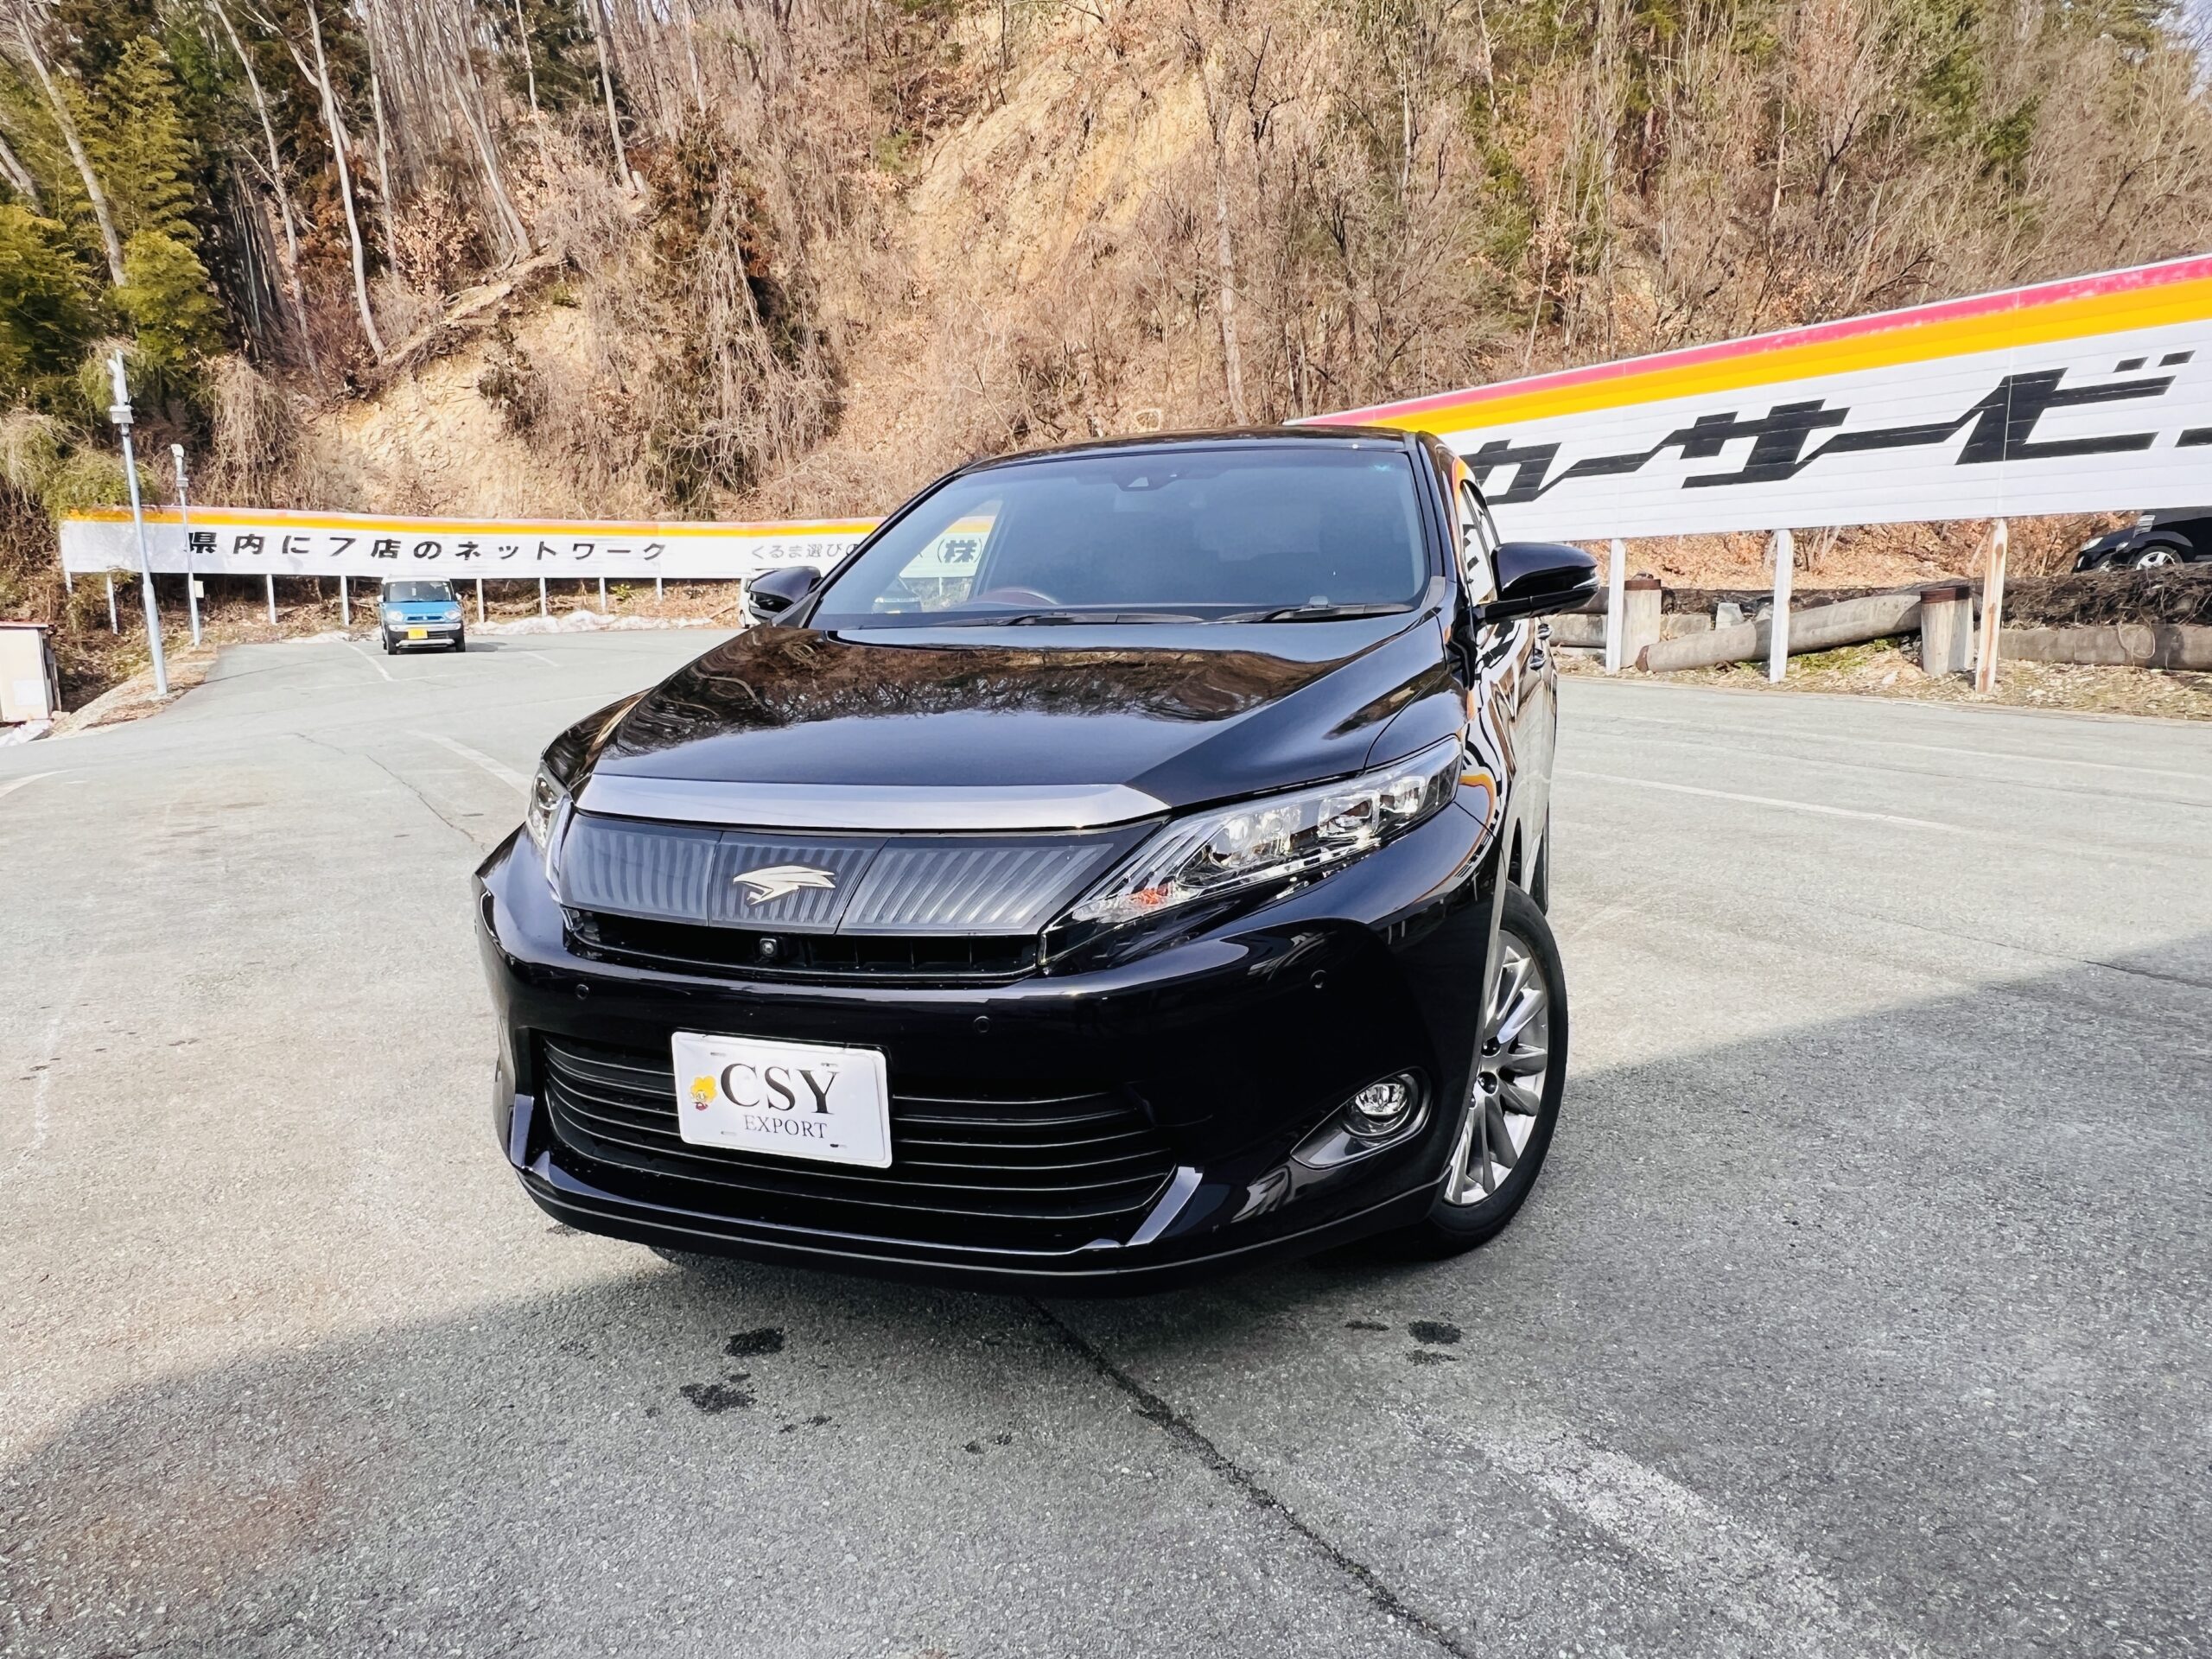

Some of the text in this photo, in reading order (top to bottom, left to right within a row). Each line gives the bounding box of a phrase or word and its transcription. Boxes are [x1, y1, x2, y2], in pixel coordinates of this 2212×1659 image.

[1458, 350, 2212, 506] カーサービ
[721, 1063, 839, 1115] CSY
[744, 1115, 828, 1138] EXPORT
